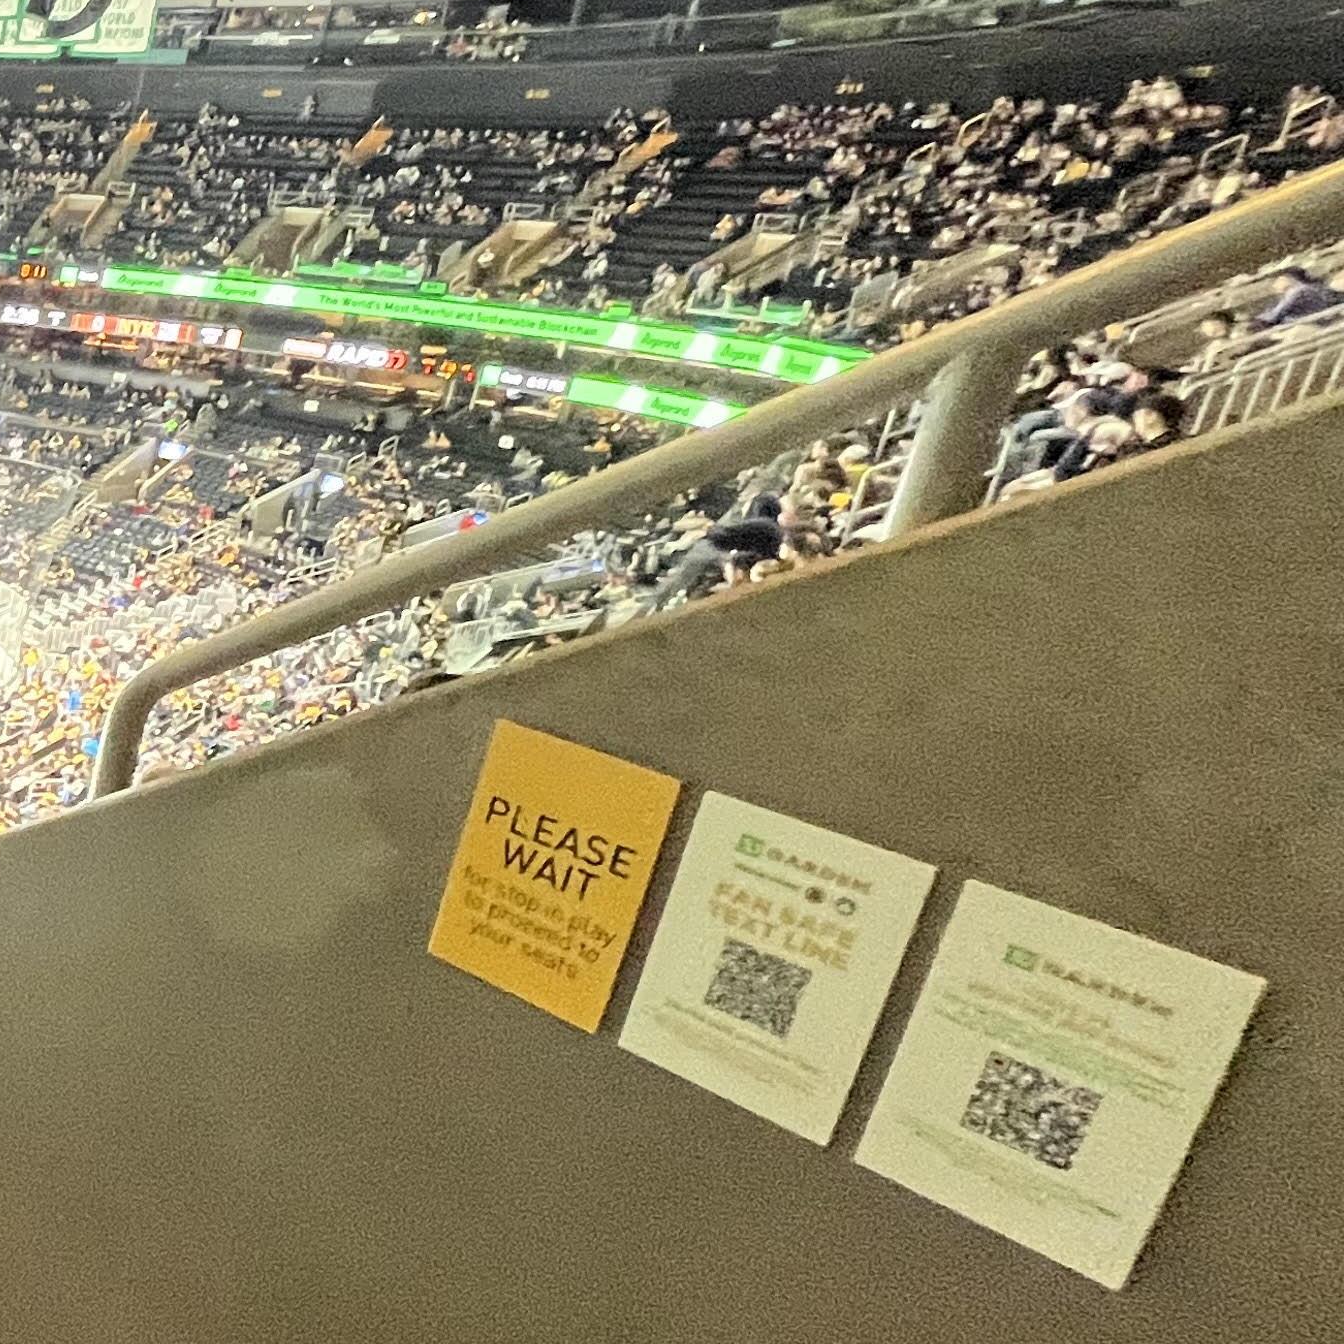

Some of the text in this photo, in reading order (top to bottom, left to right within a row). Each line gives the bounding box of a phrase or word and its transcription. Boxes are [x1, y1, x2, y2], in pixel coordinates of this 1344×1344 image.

[320, 294, 338, 305] The
[484, 796, 639, 879] PLEASE
[503, 838, 600, 901] WAIT
[492, 879, 537, 917] stop
[566, 914, 618, 948] play
